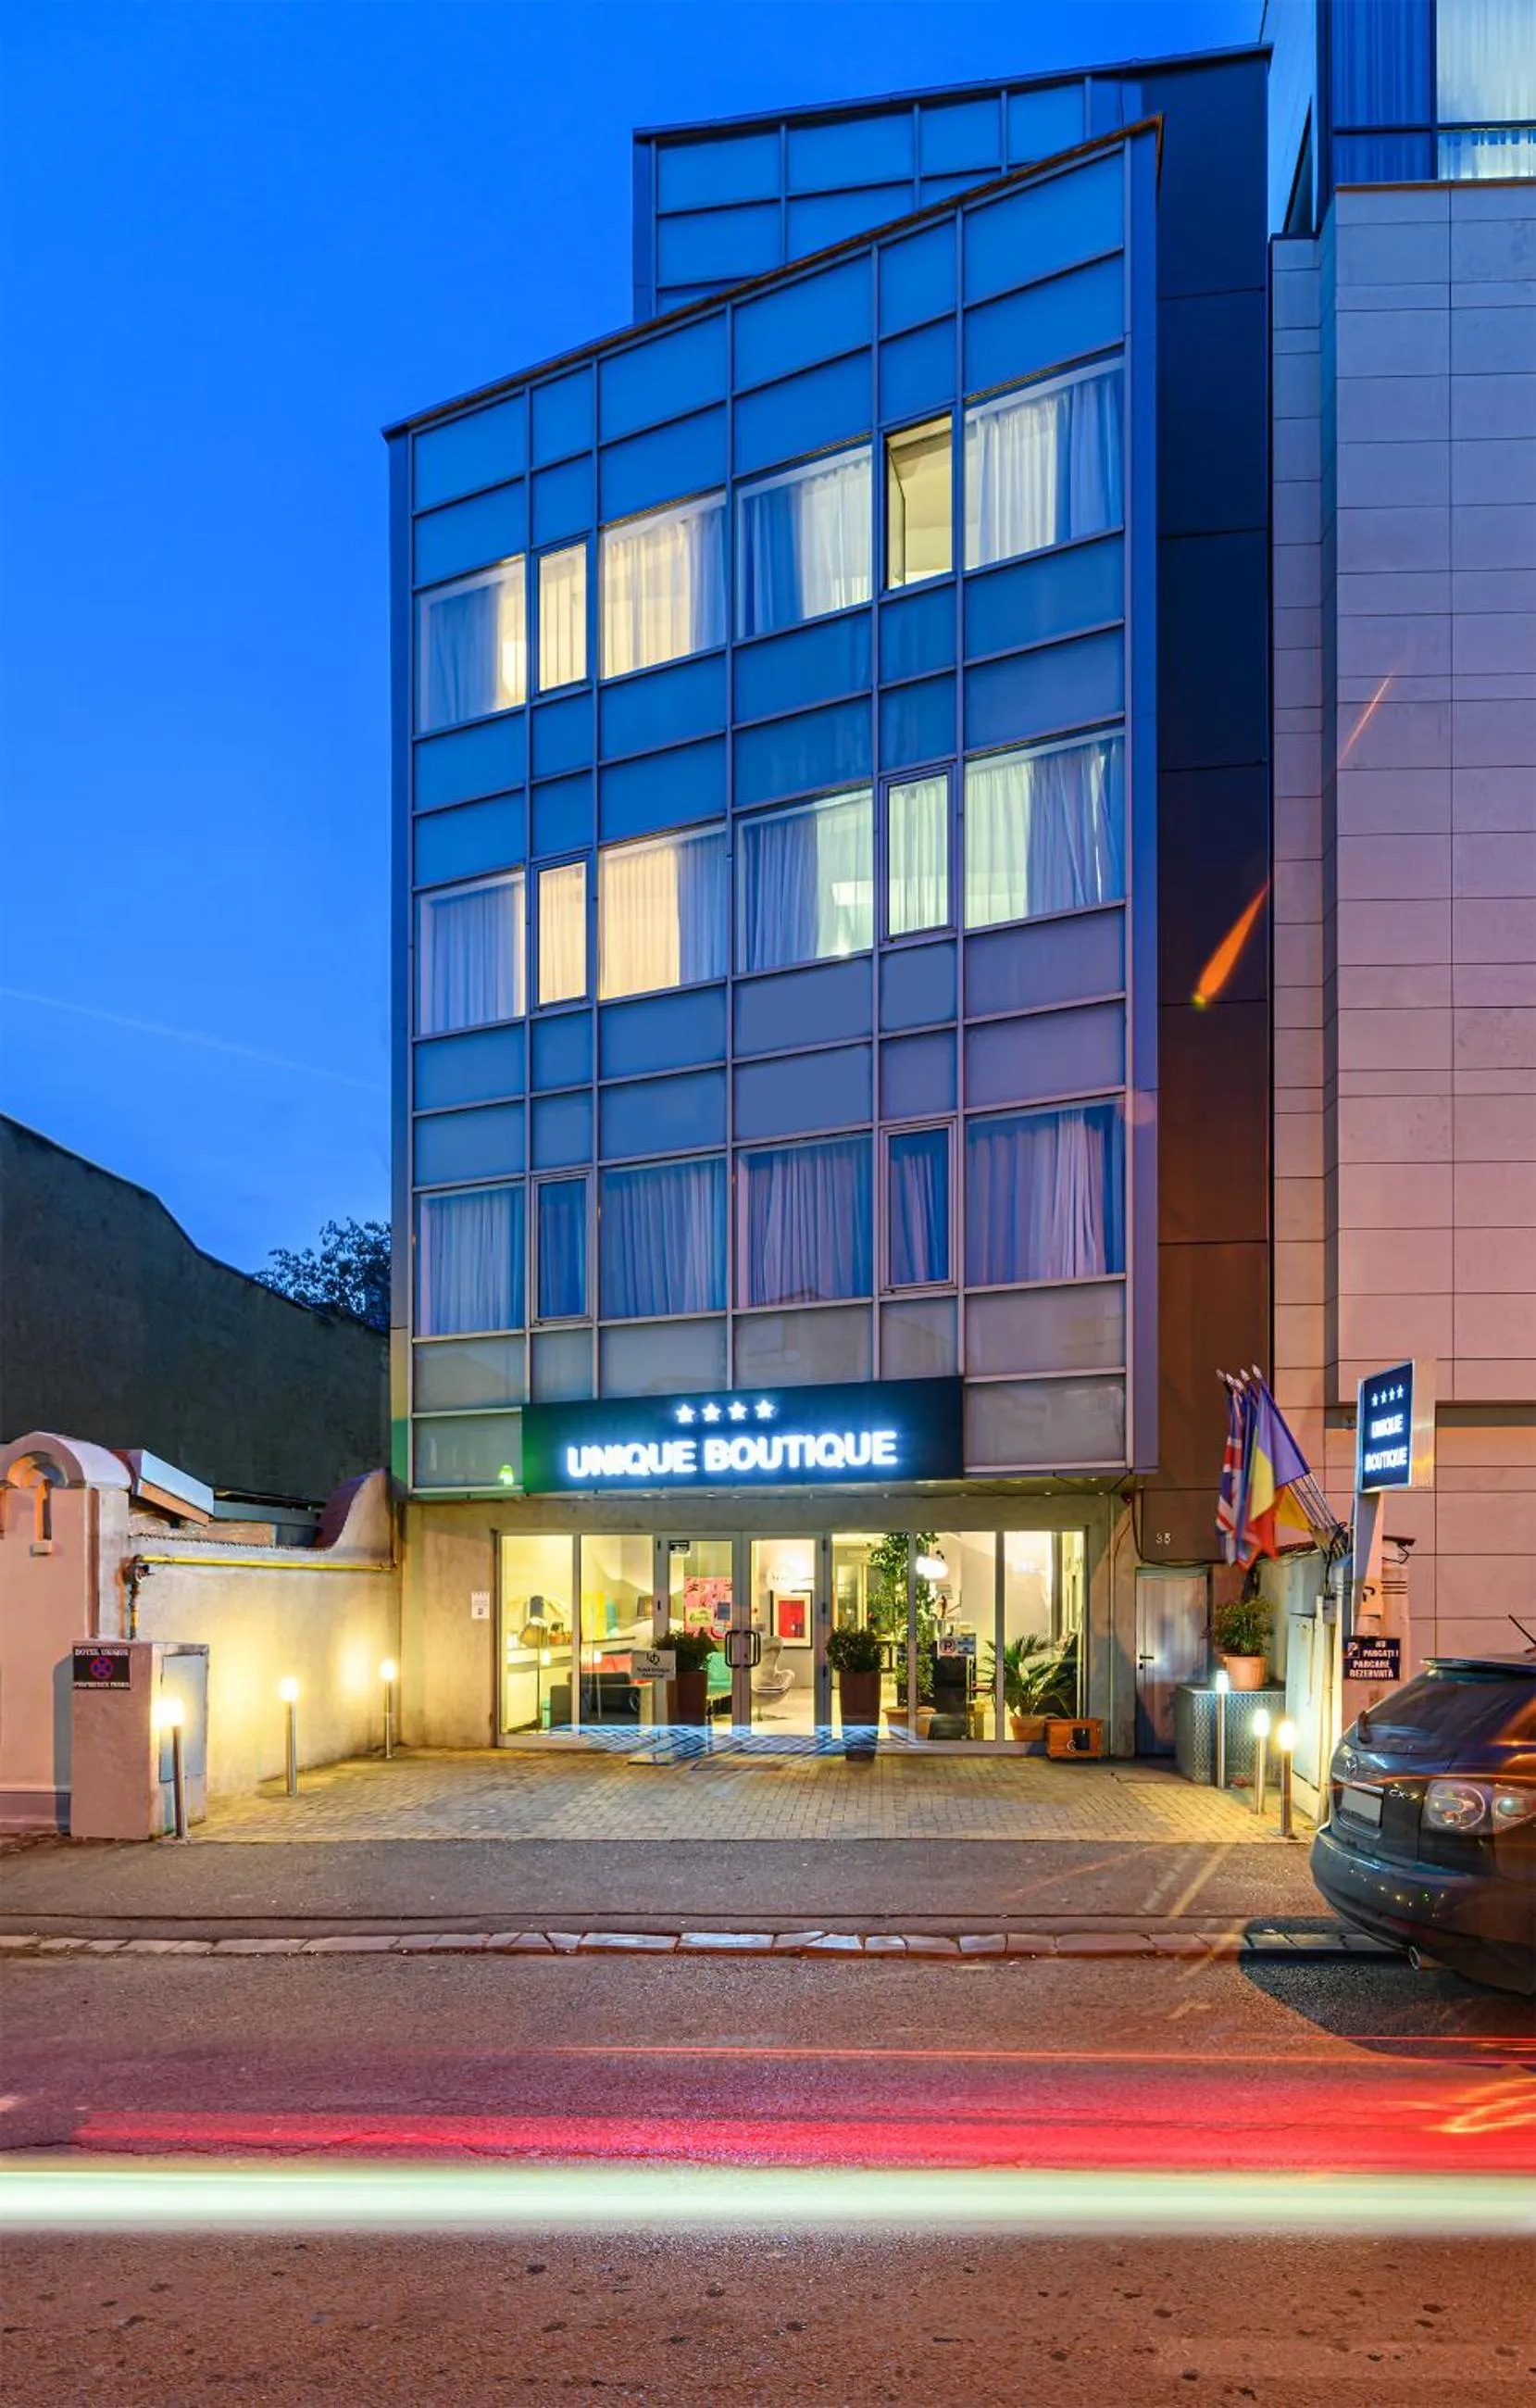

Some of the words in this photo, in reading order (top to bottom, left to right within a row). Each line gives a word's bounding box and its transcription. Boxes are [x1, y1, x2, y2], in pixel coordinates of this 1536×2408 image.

[1371, 1413, 1404, 1438] UNIQUE
[567, 1441, 697, 1478] UNIQUE
[705, 1431, 898, 1473] BOUTIQUE
[1364, 1445, 1408, 1473] BOUTIQUE
[1353, 1660, 1390, 1668] PARCARE
